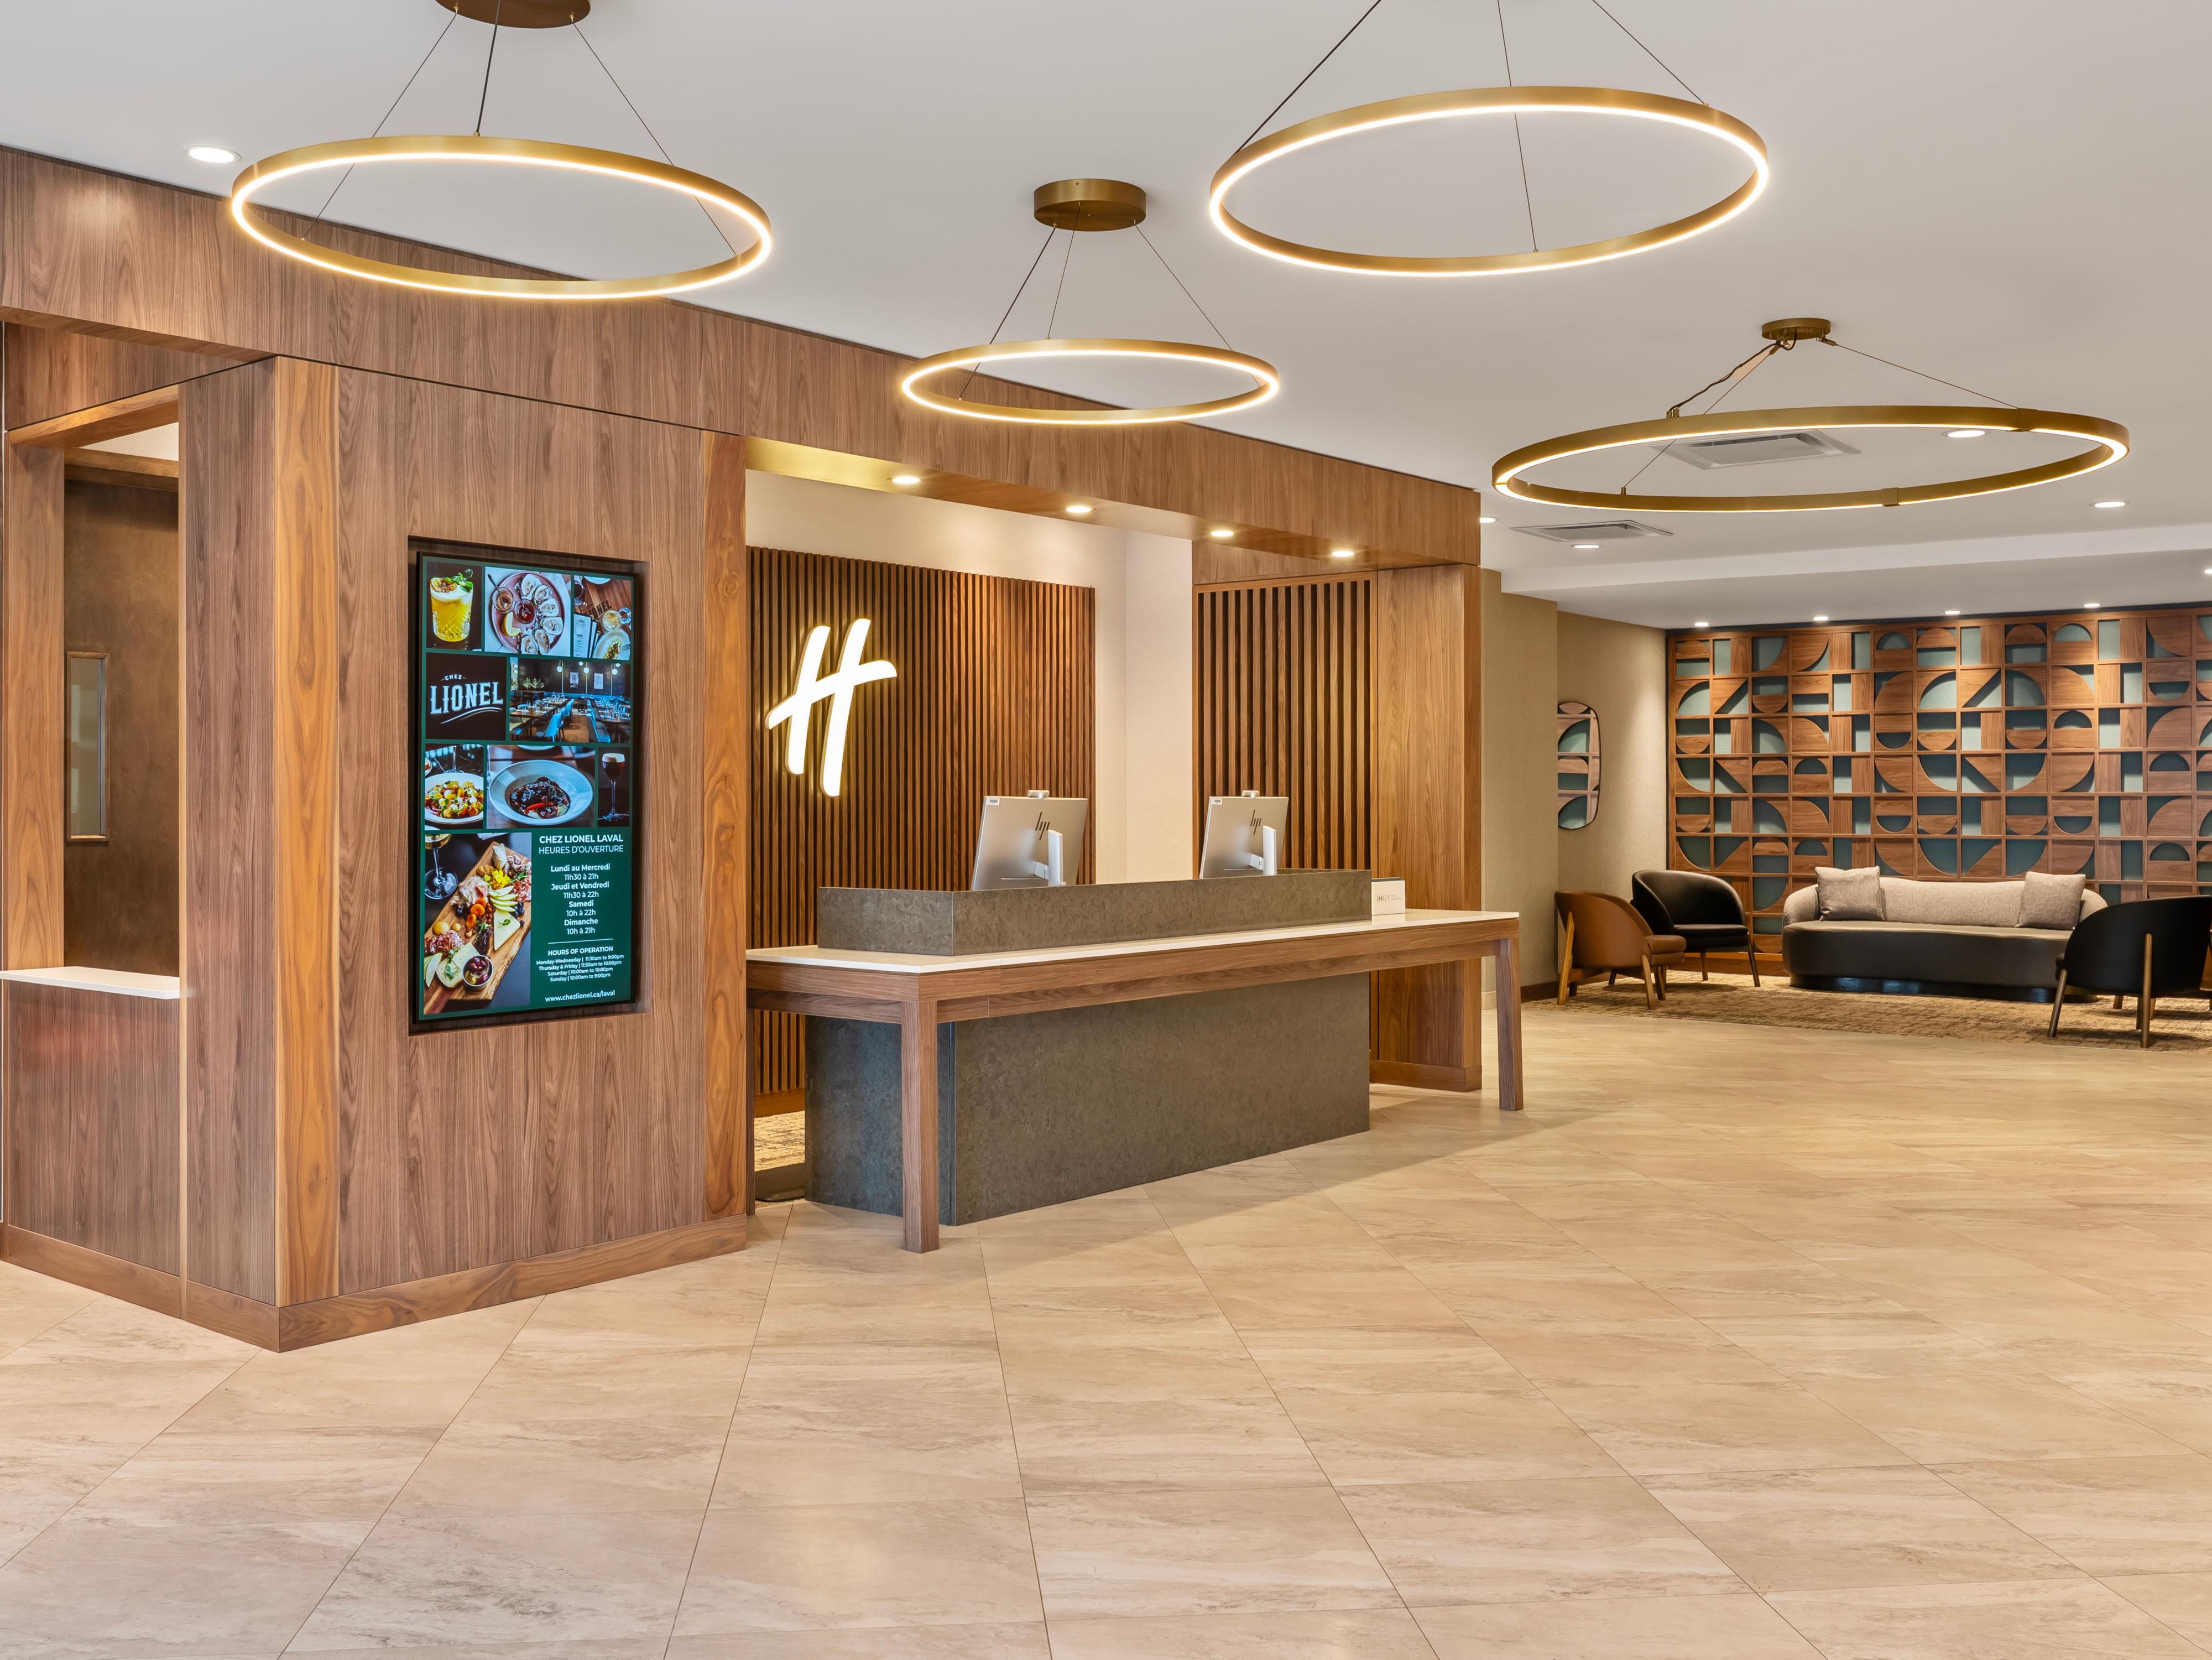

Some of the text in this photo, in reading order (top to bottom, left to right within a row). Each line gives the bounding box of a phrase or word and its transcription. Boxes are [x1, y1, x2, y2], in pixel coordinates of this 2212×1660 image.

[430, 681, 503, 714] LIONEL
[539, 835, 563, 844] CHEZ
[565, 835, 595, 843] LIONEL
[572, 845, 624, 854] D'OUVERTURE
[545, 990, 615, 1002] www.chezlionel.ca/laval
